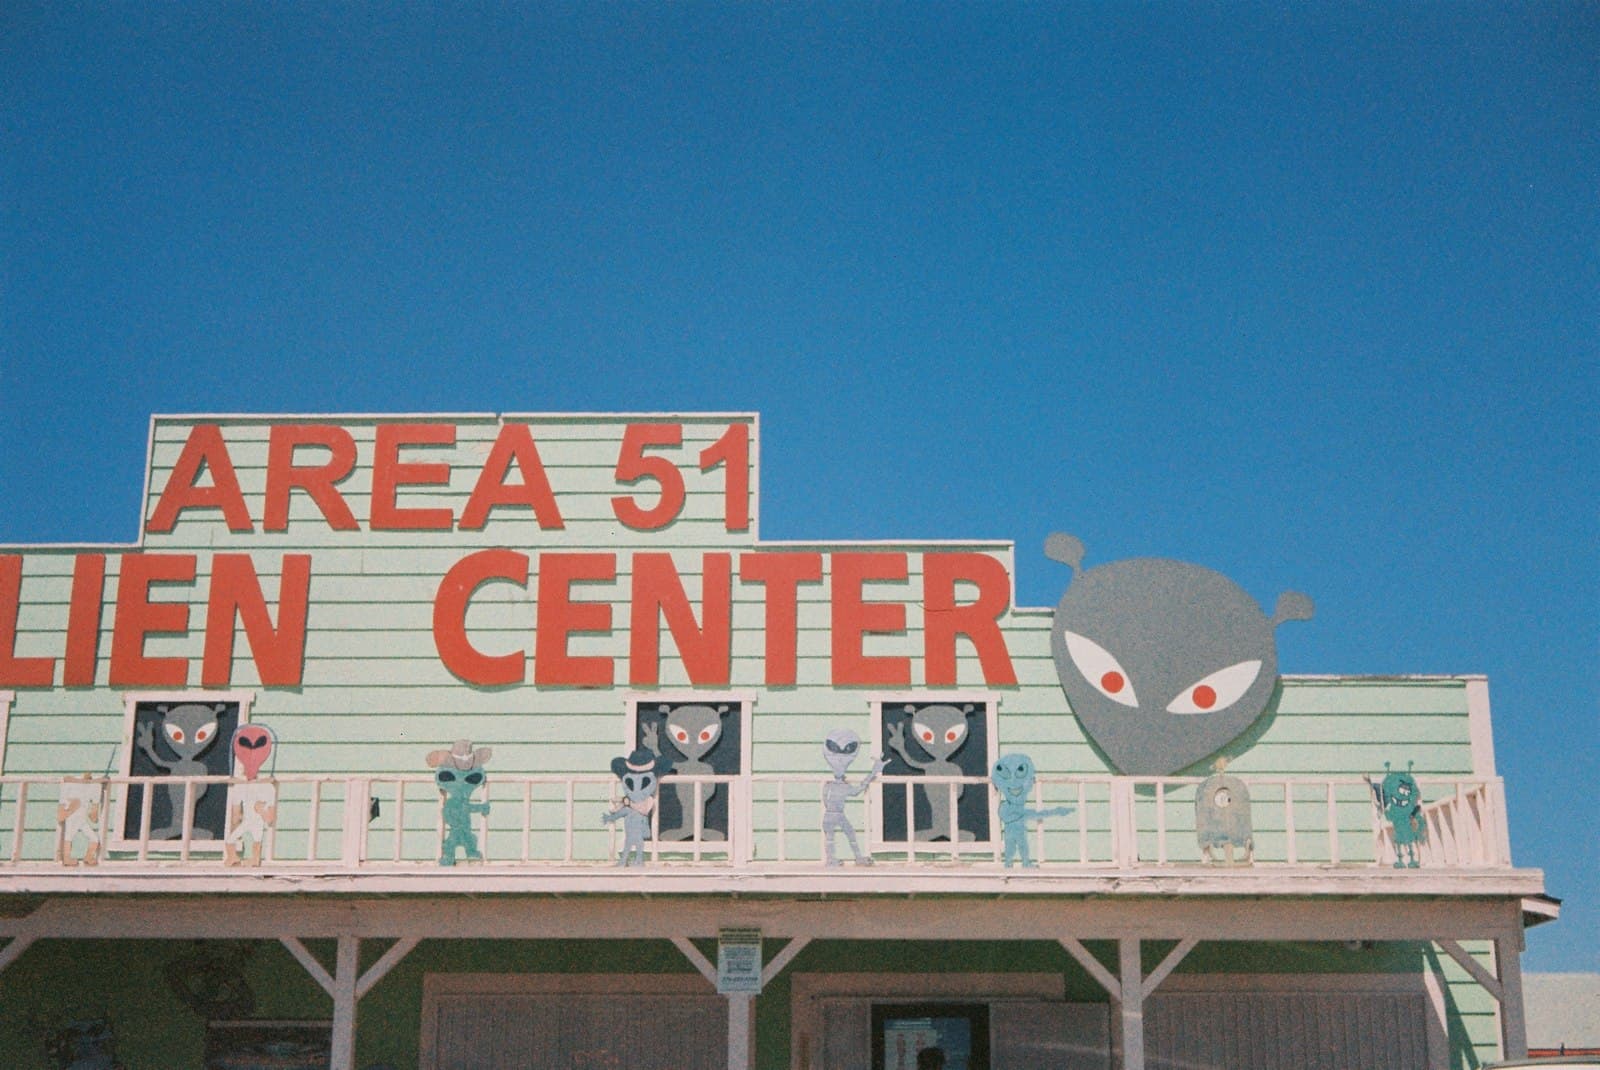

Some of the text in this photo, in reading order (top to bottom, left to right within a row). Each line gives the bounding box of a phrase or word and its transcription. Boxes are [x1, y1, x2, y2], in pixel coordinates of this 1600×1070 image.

[147, 423, 749, 531] AREA 51
[0, 548, 1017, 687] LIEN CENTER
